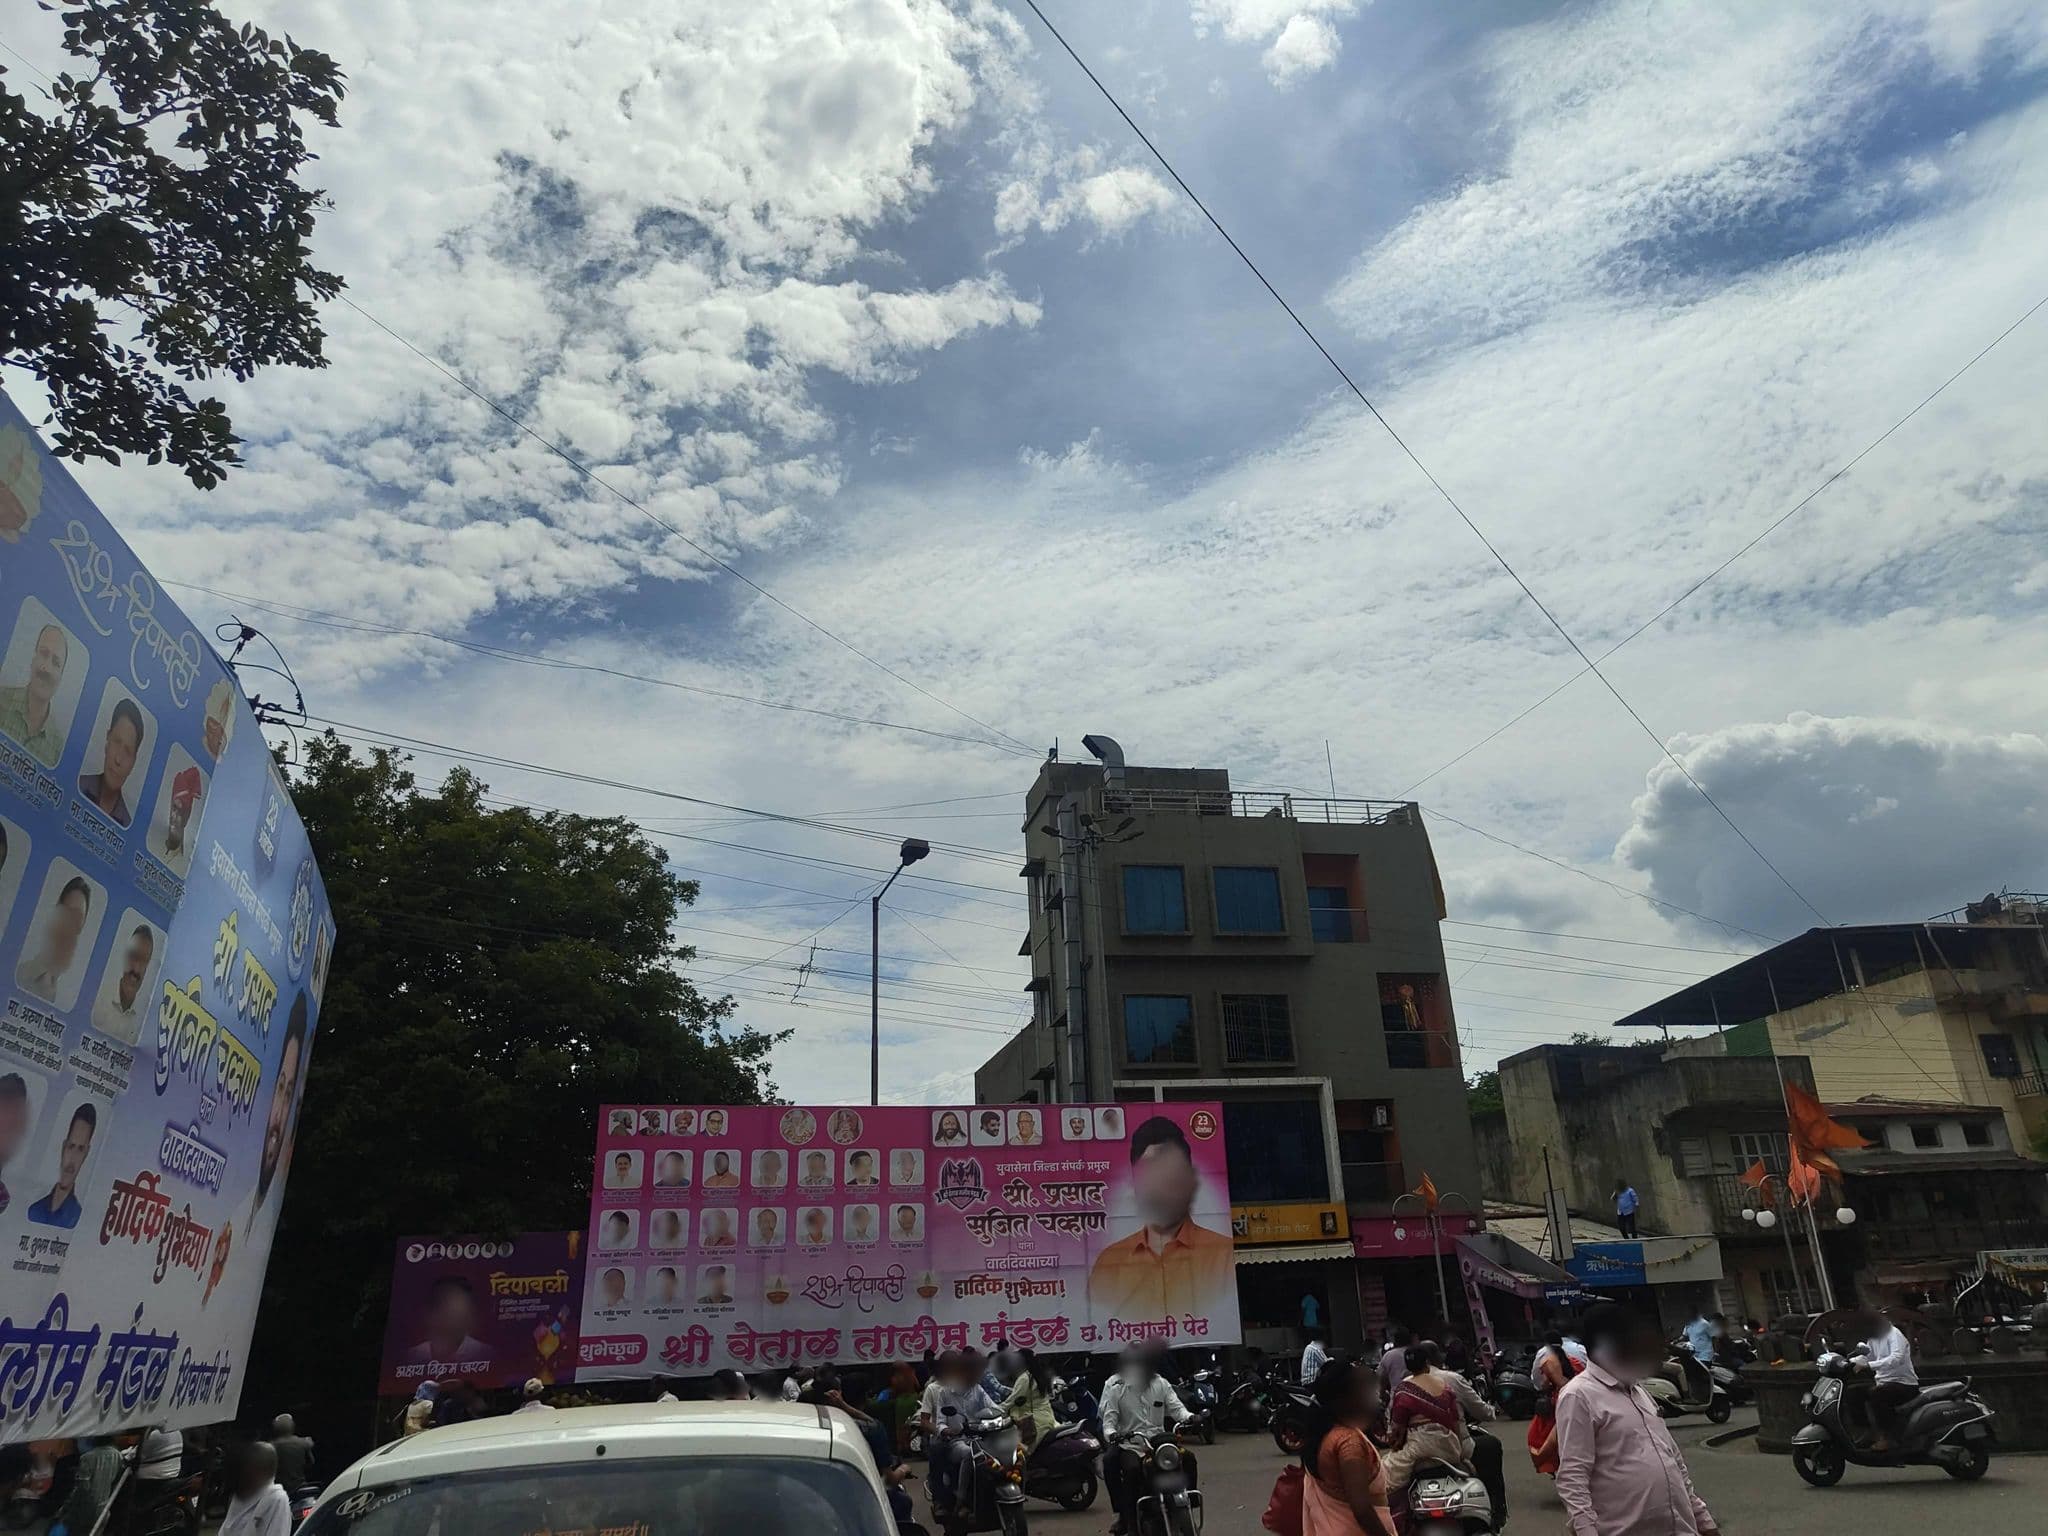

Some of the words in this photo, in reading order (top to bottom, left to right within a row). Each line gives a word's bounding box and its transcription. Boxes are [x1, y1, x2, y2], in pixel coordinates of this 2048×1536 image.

[995, 1161, 1031, 1176] युवासेना
[1033, 1160, 1060, 1172] जिल्हा
[1061, 1159, 1085, 1171] संपर्क
[1087, 1160, 1110, 1174] प्रमुख
[1002, 1177, 1041, 1207] श्री.
[1040, 1181, 1109, 1207] प्रसाद
[965, 1205, 1033, 1246] सुजित
[1035, 1211, 1109, 1242] चव्हाण
[985, 1253, 1059, 1270] वाढदिवसाच्या
[954, 1274, 1004, 1299] हार्दिक
[1004, 1276, 1066, 1304] शुभेच्छा!
[661, 1324, 714, 1366] श्री
[726, 1322, 842, 1364] वेताळ
[852, 1314, 970, 1357] तालीम
[980, 1311, 1071, 1347] मंडळ
[1107, 1315, 1177, 1342] शिवाजी
[1183, 1313, 1209, 1336] पेठ
